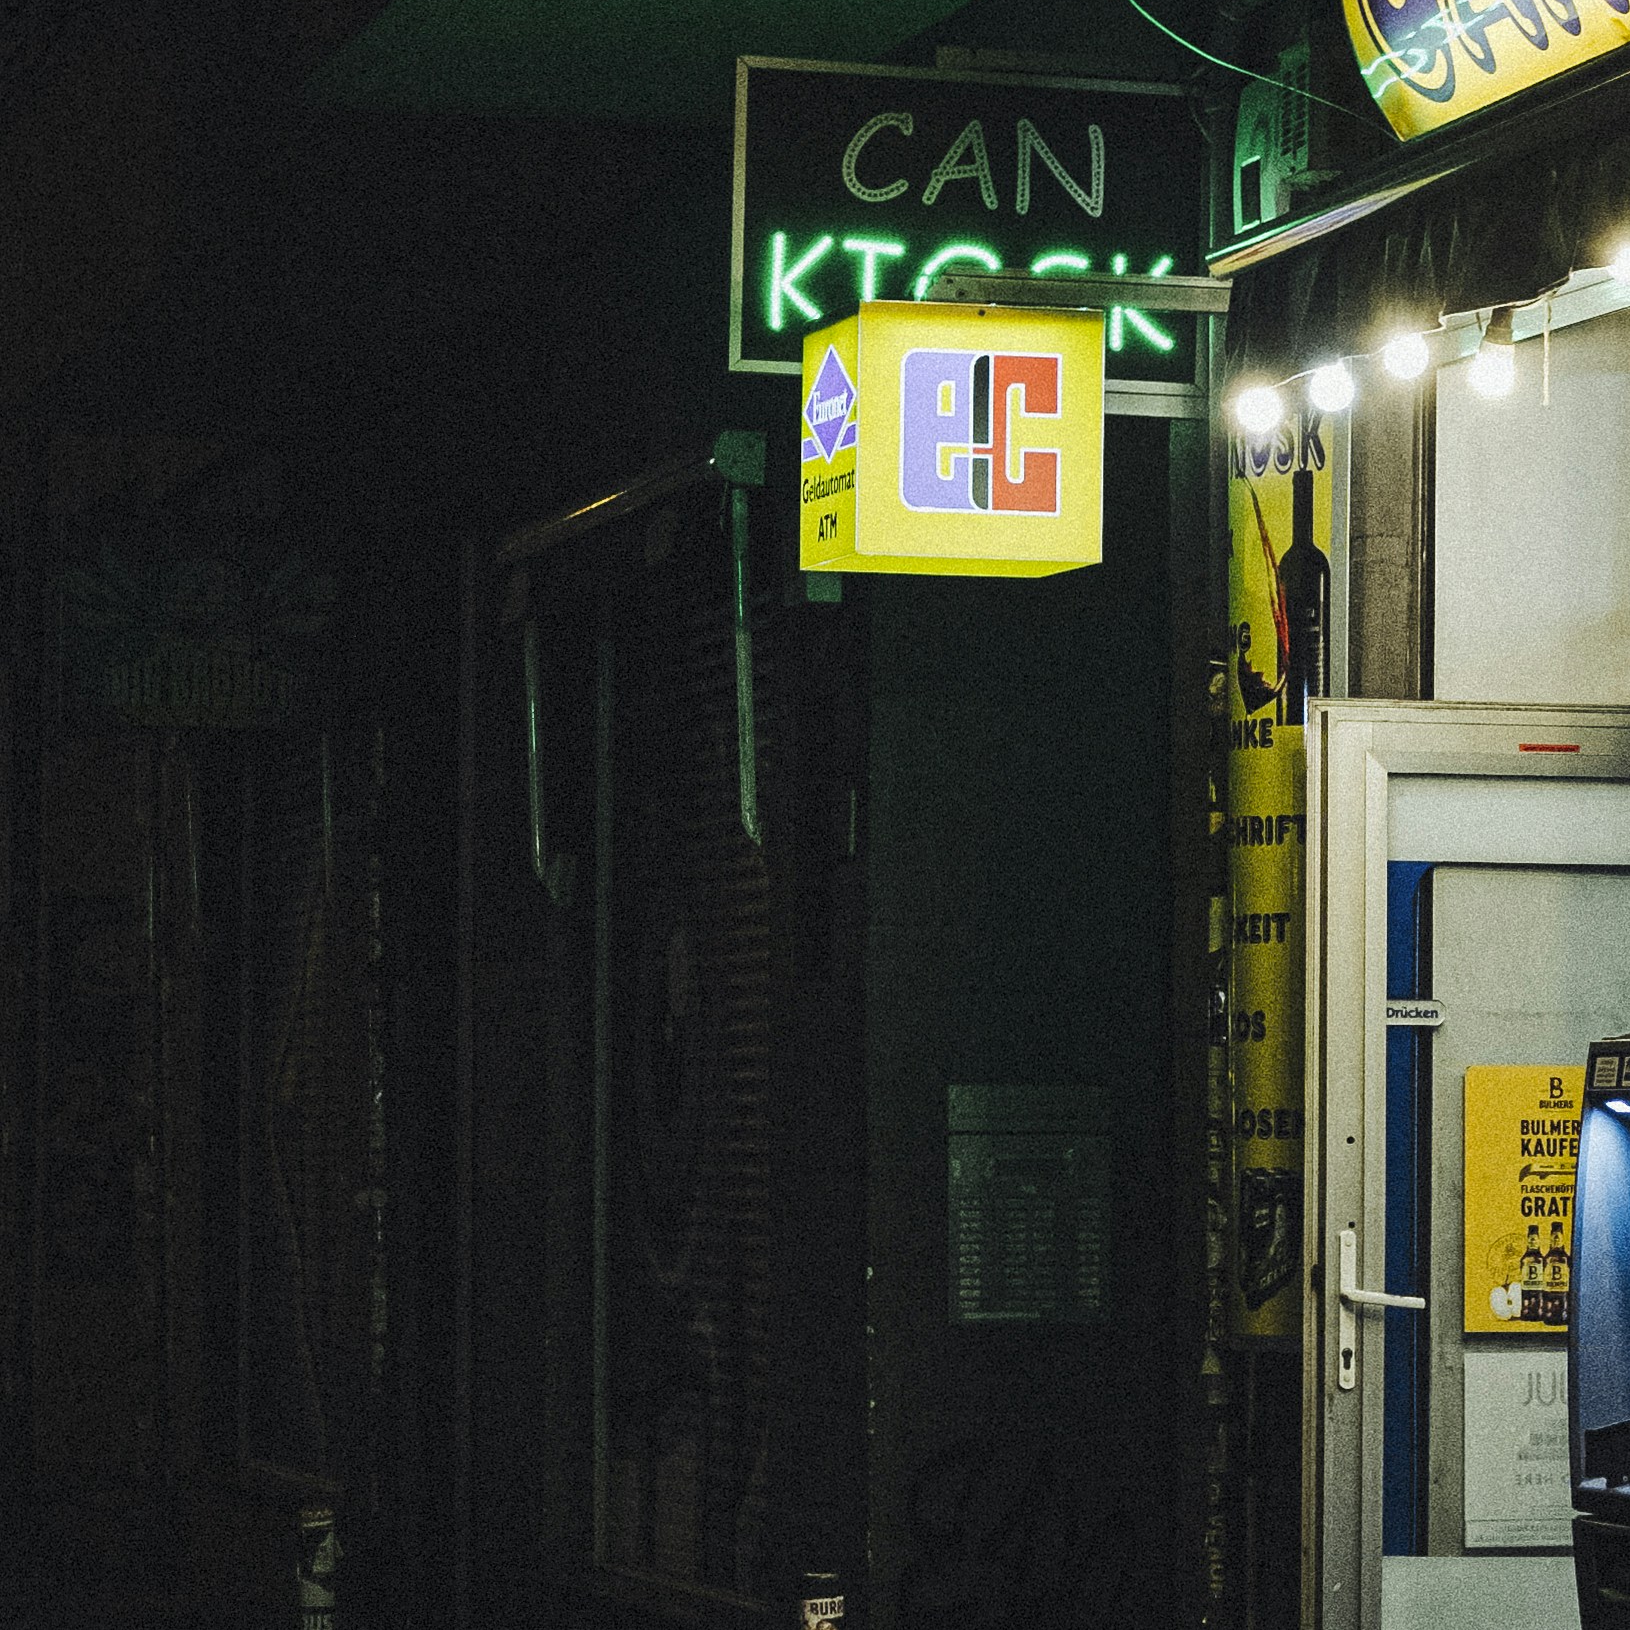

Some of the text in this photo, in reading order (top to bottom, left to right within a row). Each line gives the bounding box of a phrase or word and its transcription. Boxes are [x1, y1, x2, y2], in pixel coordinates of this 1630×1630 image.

[841, 111, 1106, 218] CAN
[802, 468, 856, 504] Geldautomat
[817, 510, 838, 543] ATM
[1385, 1004, 1440, 1021] Drücken
[1539, 1100, 1574, 1109] BULMERS
